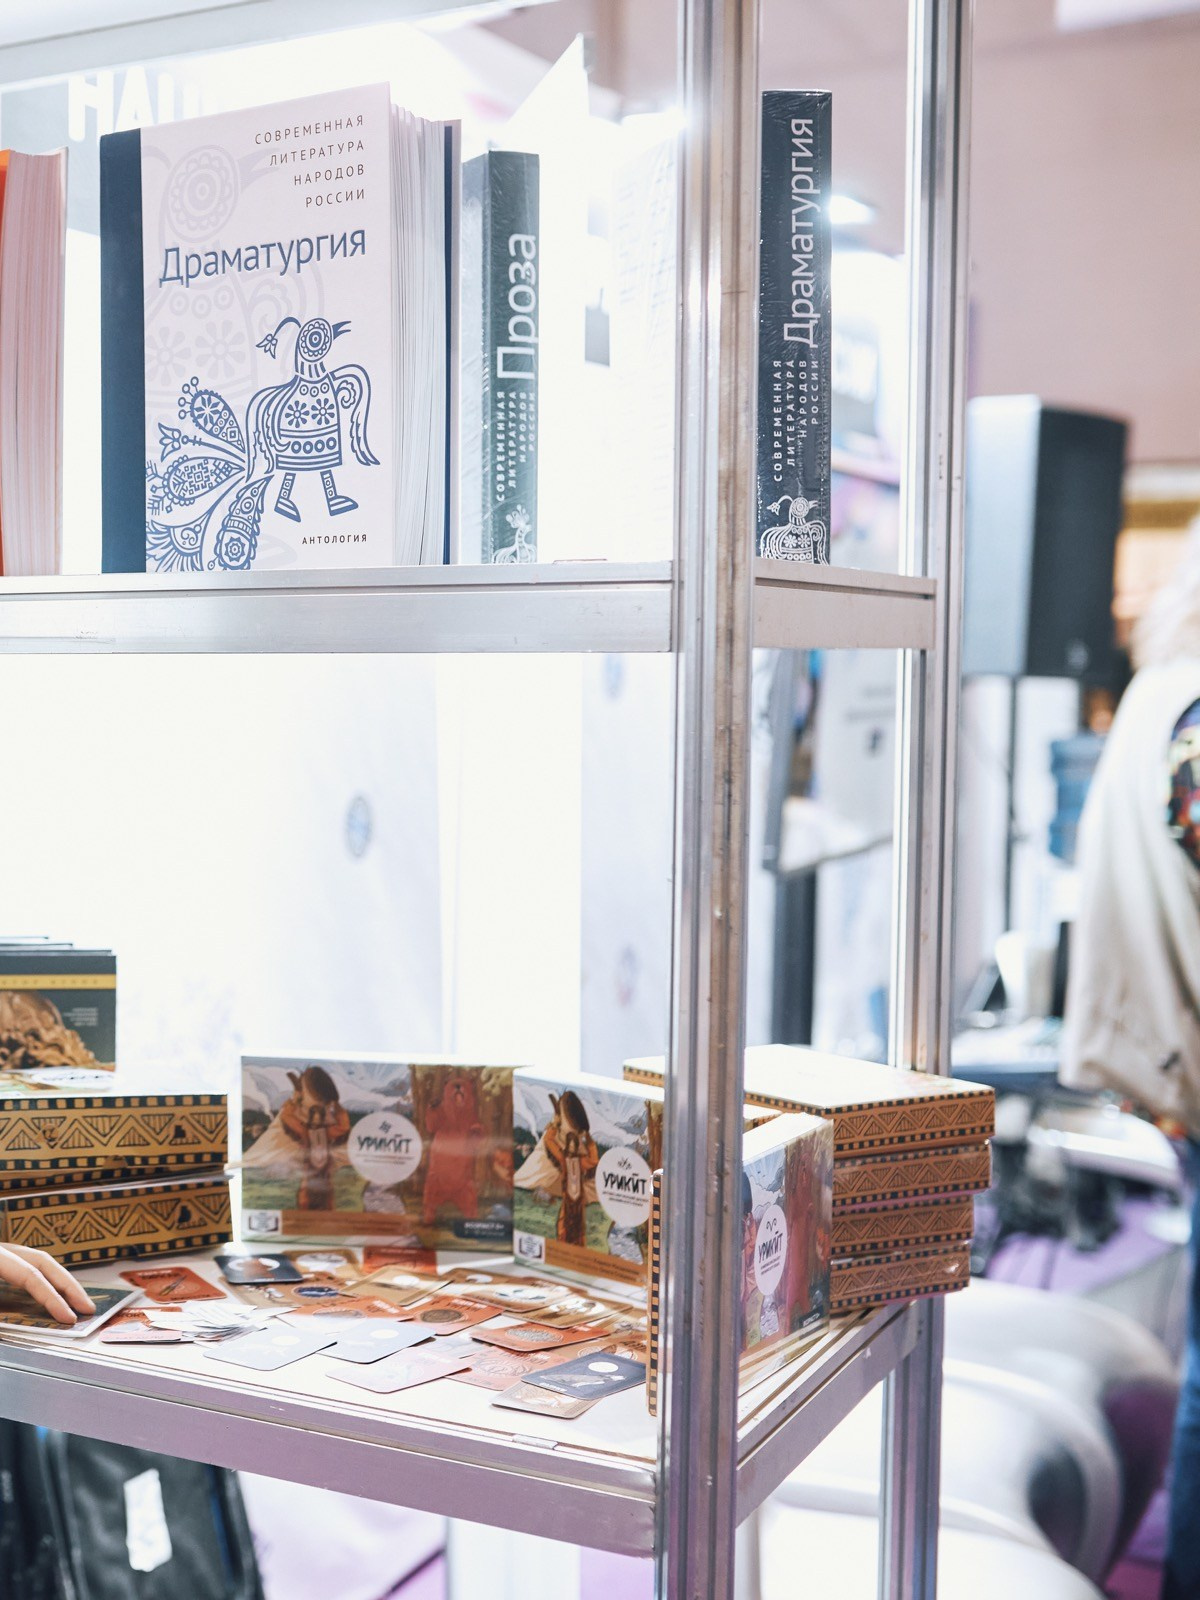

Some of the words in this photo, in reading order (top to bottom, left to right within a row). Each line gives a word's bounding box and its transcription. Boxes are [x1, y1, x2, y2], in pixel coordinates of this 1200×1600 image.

[254, 114, 363, 145] СОВРЕМЕННАЯ
[269, 140, 364, 166] ЛИТЕРАТУРА
[294, 163, 364, 186] НАРОДОВ
[305, 188, 365, 208] РОССИИ
[159, 229, 366, 289] Драматургия
[783, 117, 821, 349] Драматургия
[497, 233, 539, 380] Проза
[773, 360, 783, 482] СОВРЕМЕННАЯ
[786, 359, 796, 467] ЛИТЕРАТУРА
[799, 360, 808, 438] НАРОДОВ
[810, 360, 819, 425] РОССИИ
[496, 391, 506, 503] СОВРЕМЕННАЯ
[508, 391, 517, 489] ЛИТЕРАТУРА
[302, 534, 367, 545] АНТОЛОГИЯ
